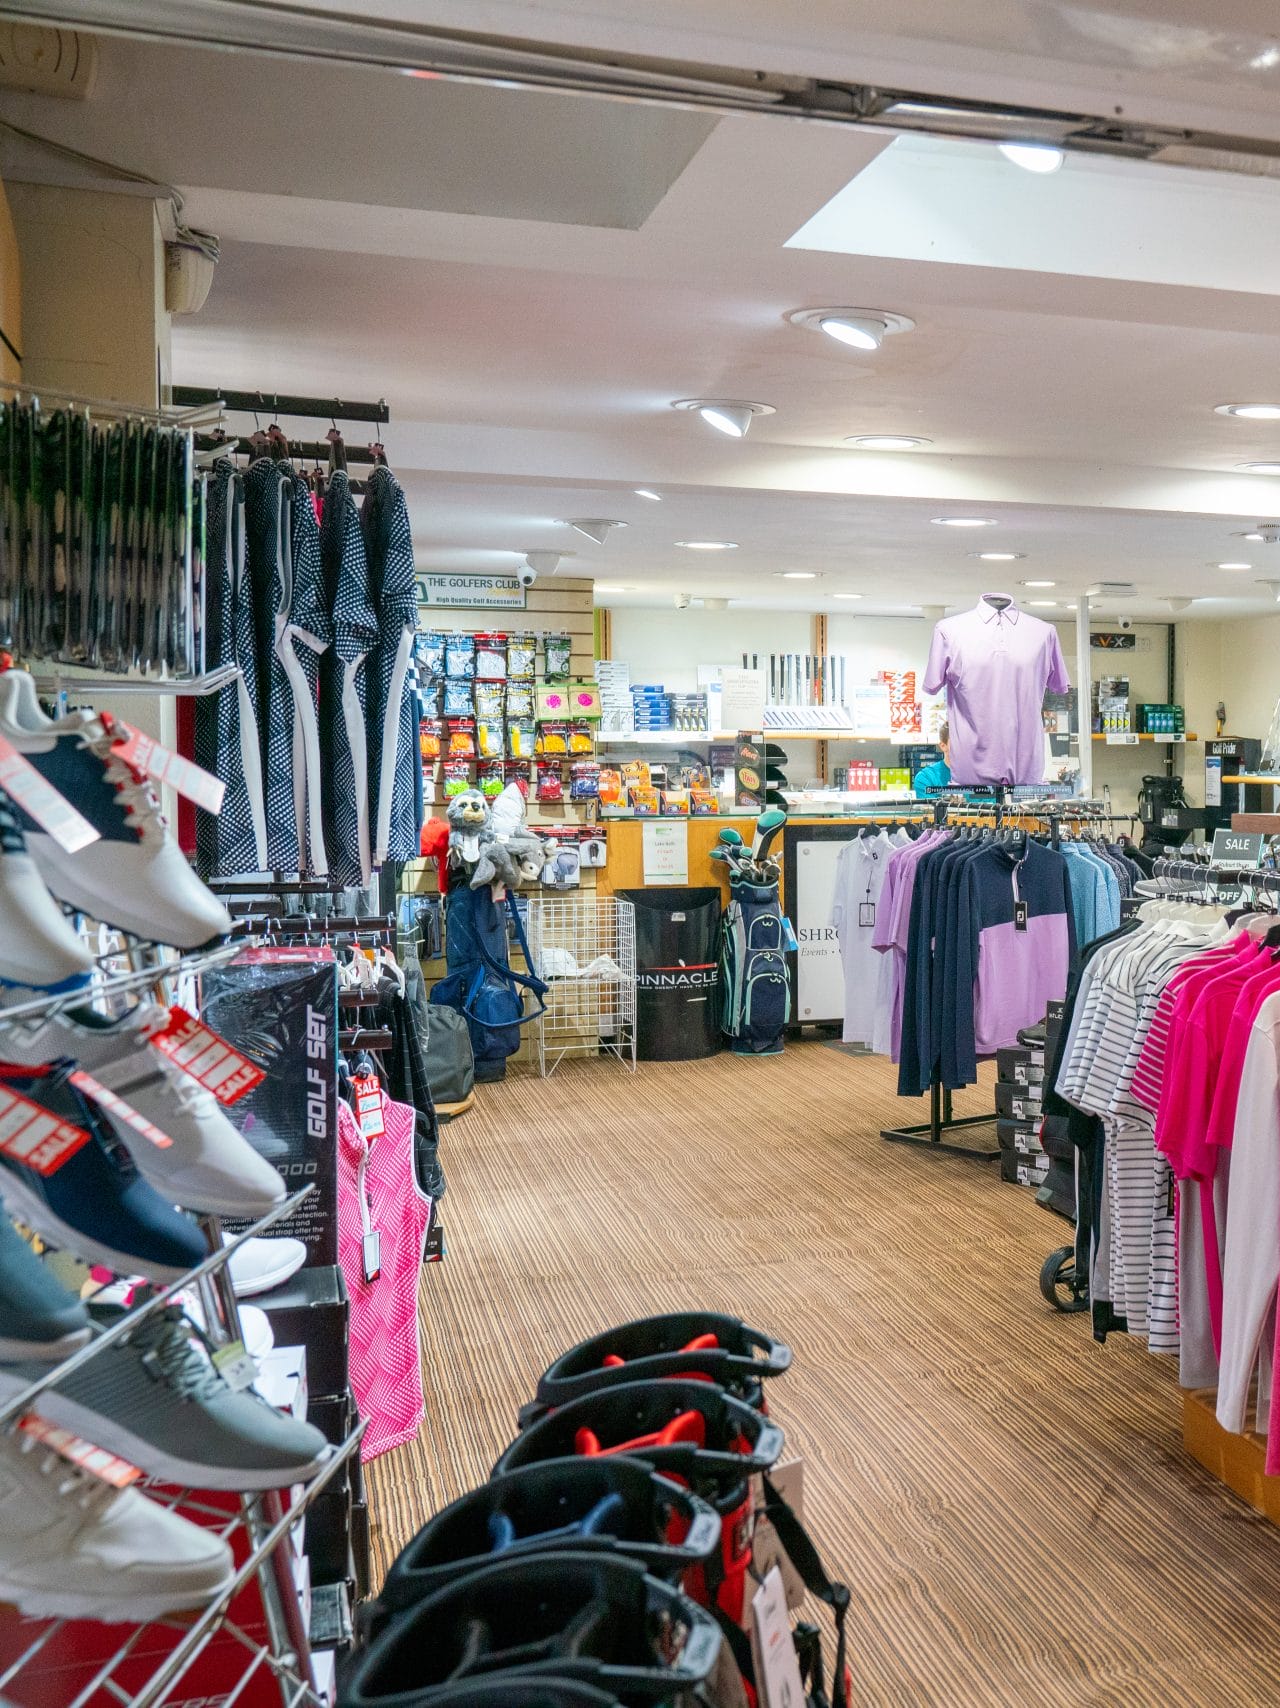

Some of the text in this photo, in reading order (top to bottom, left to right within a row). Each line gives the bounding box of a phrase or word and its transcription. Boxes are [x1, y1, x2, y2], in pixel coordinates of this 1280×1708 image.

[428, 577, 521, 589] THE GOLFERS CLUB
[1212, 742, 1237, 755] Golf Pride
[1225, 838, 1250, 850] SALE
[1219, 891, 1240, 901] OFF
[801, 947, 828, 957] Events
[634, 970, 718, 985] PINNACLE
[160, 1019, 202, 1053] SALE
[307, 1004, 327, 1139] GOLF SET
[215, 1064, 259, 1101] SALE
[357, 1080, 379, 1096] SALE
[29, 1125, 79, 1170] SALE
[275, 1228, 294, 1236] strap
